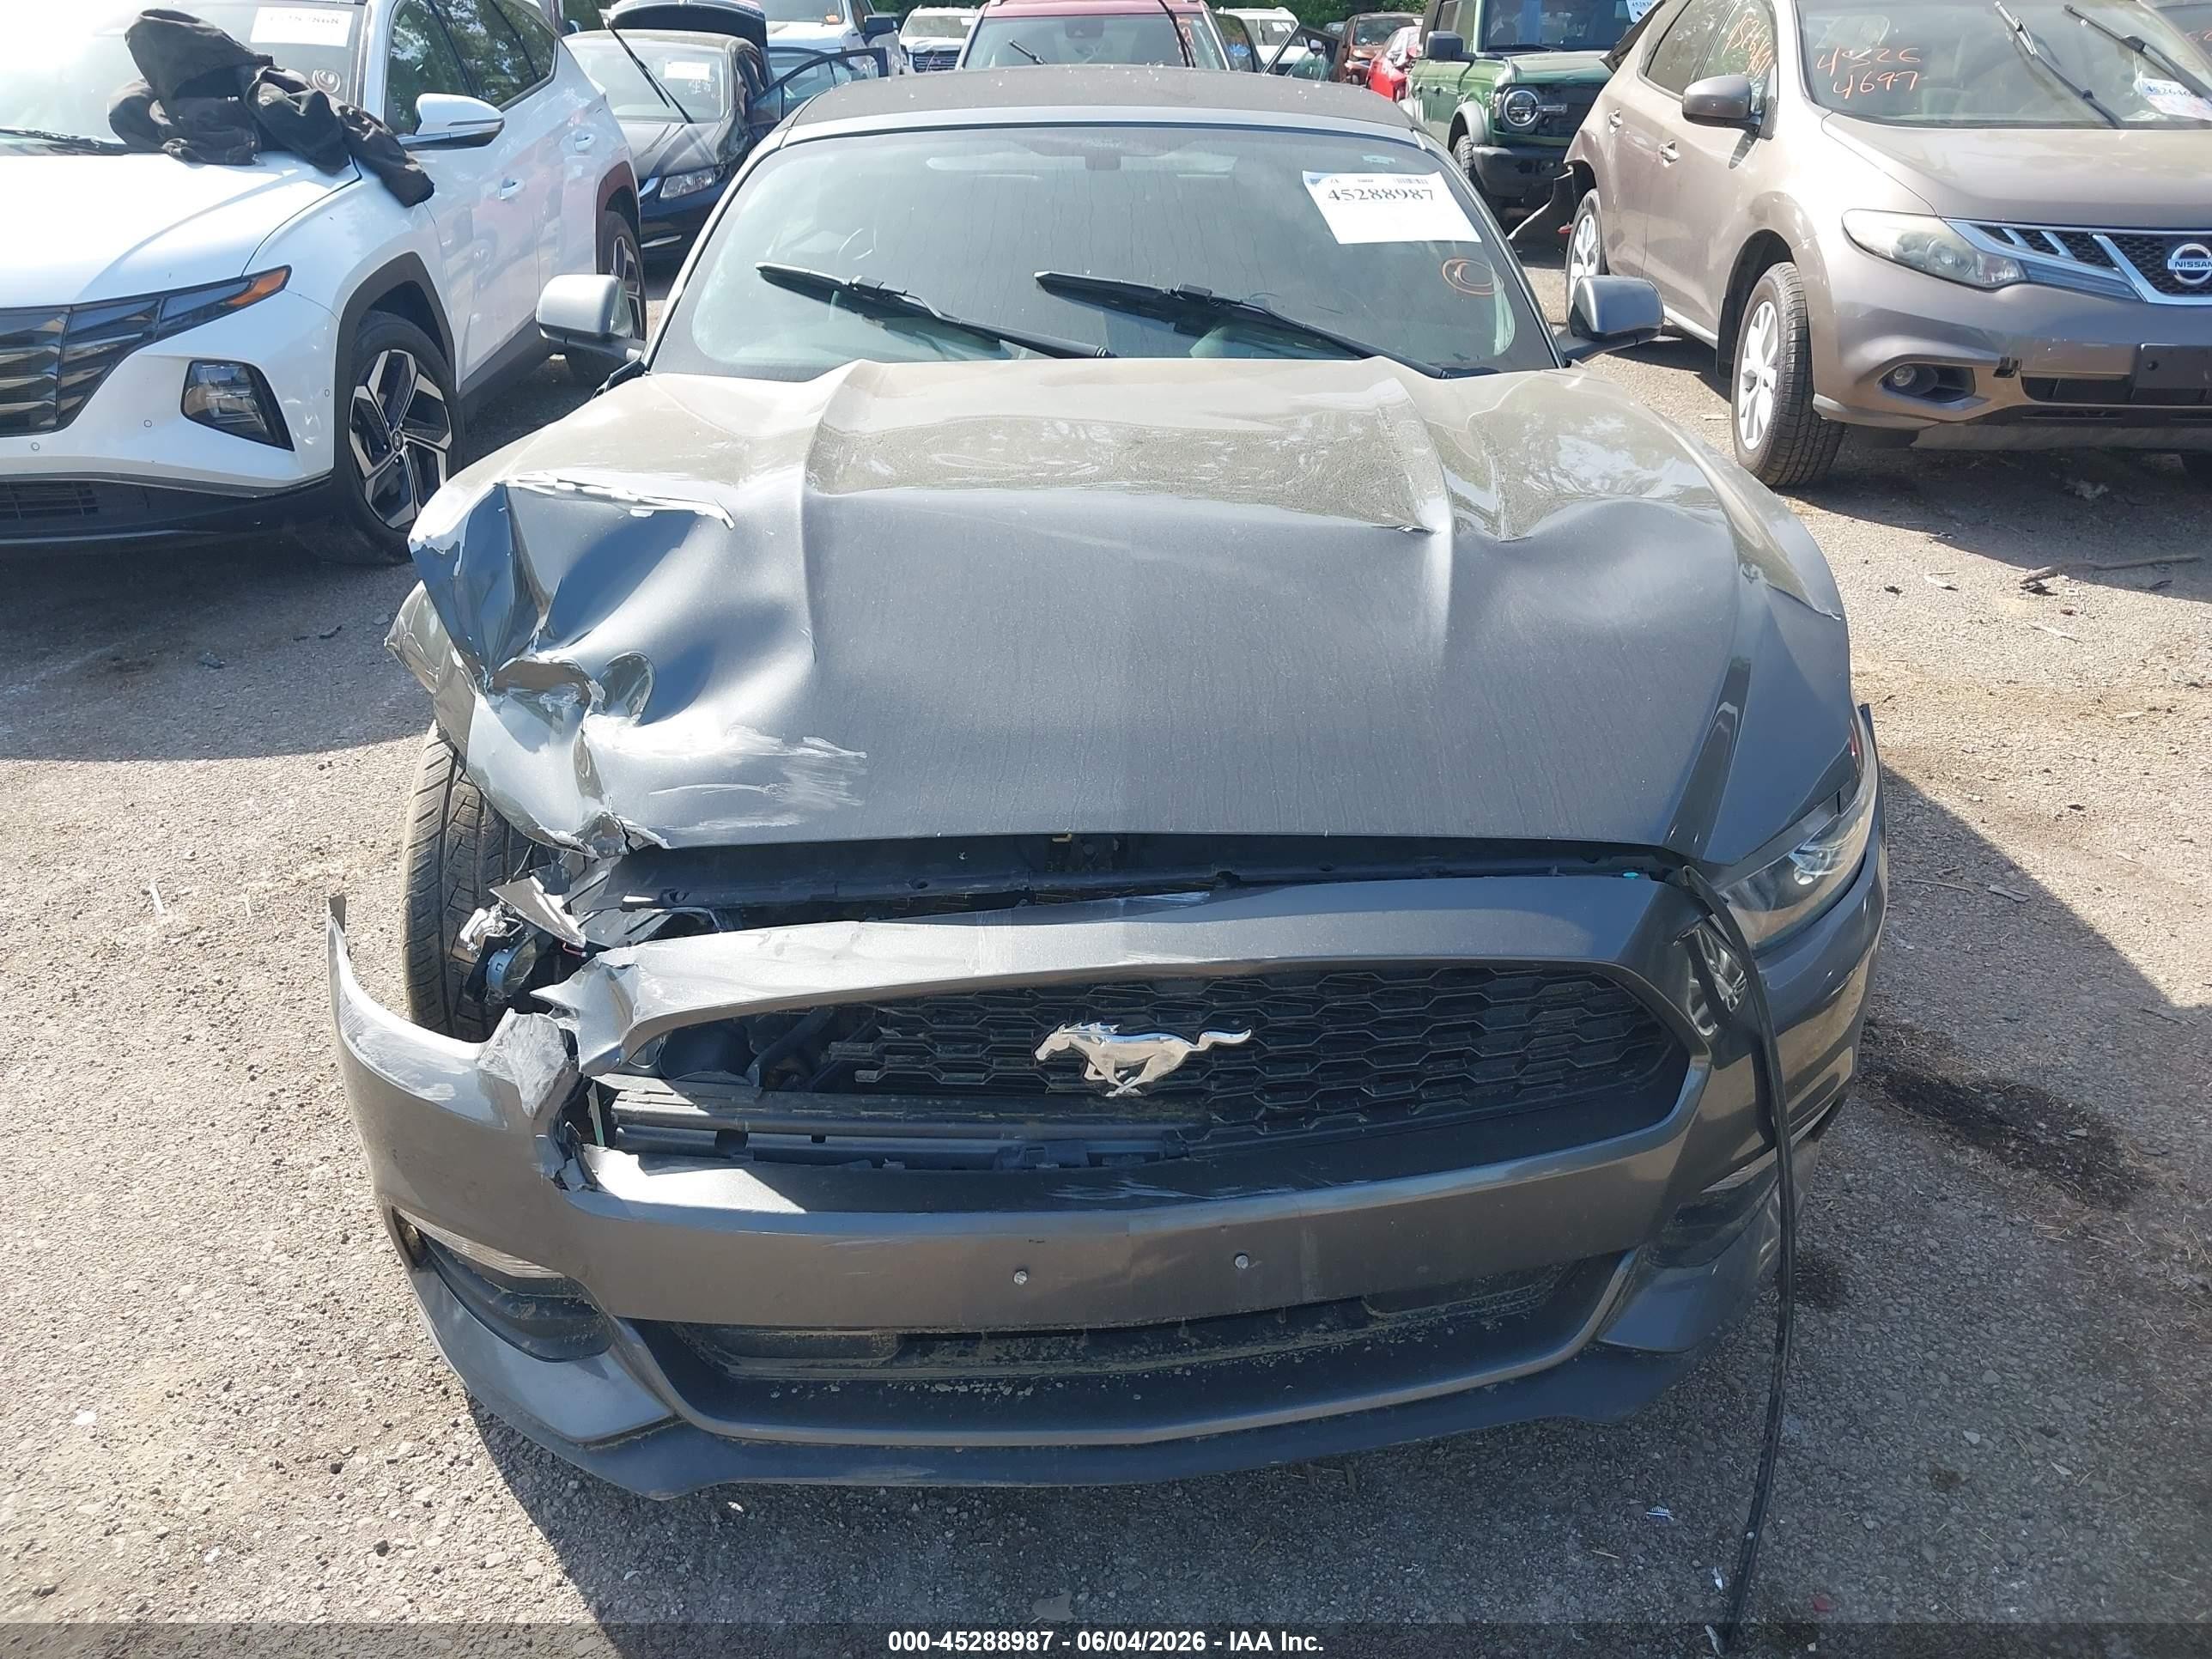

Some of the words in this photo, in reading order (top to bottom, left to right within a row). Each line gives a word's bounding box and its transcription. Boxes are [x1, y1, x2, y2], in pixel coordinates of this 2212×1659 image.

[1816, 47, 1921, 77] 4526
[1832, 70, 1918, 100] 4697
[1328, 188, 1434, 201] 45288987
